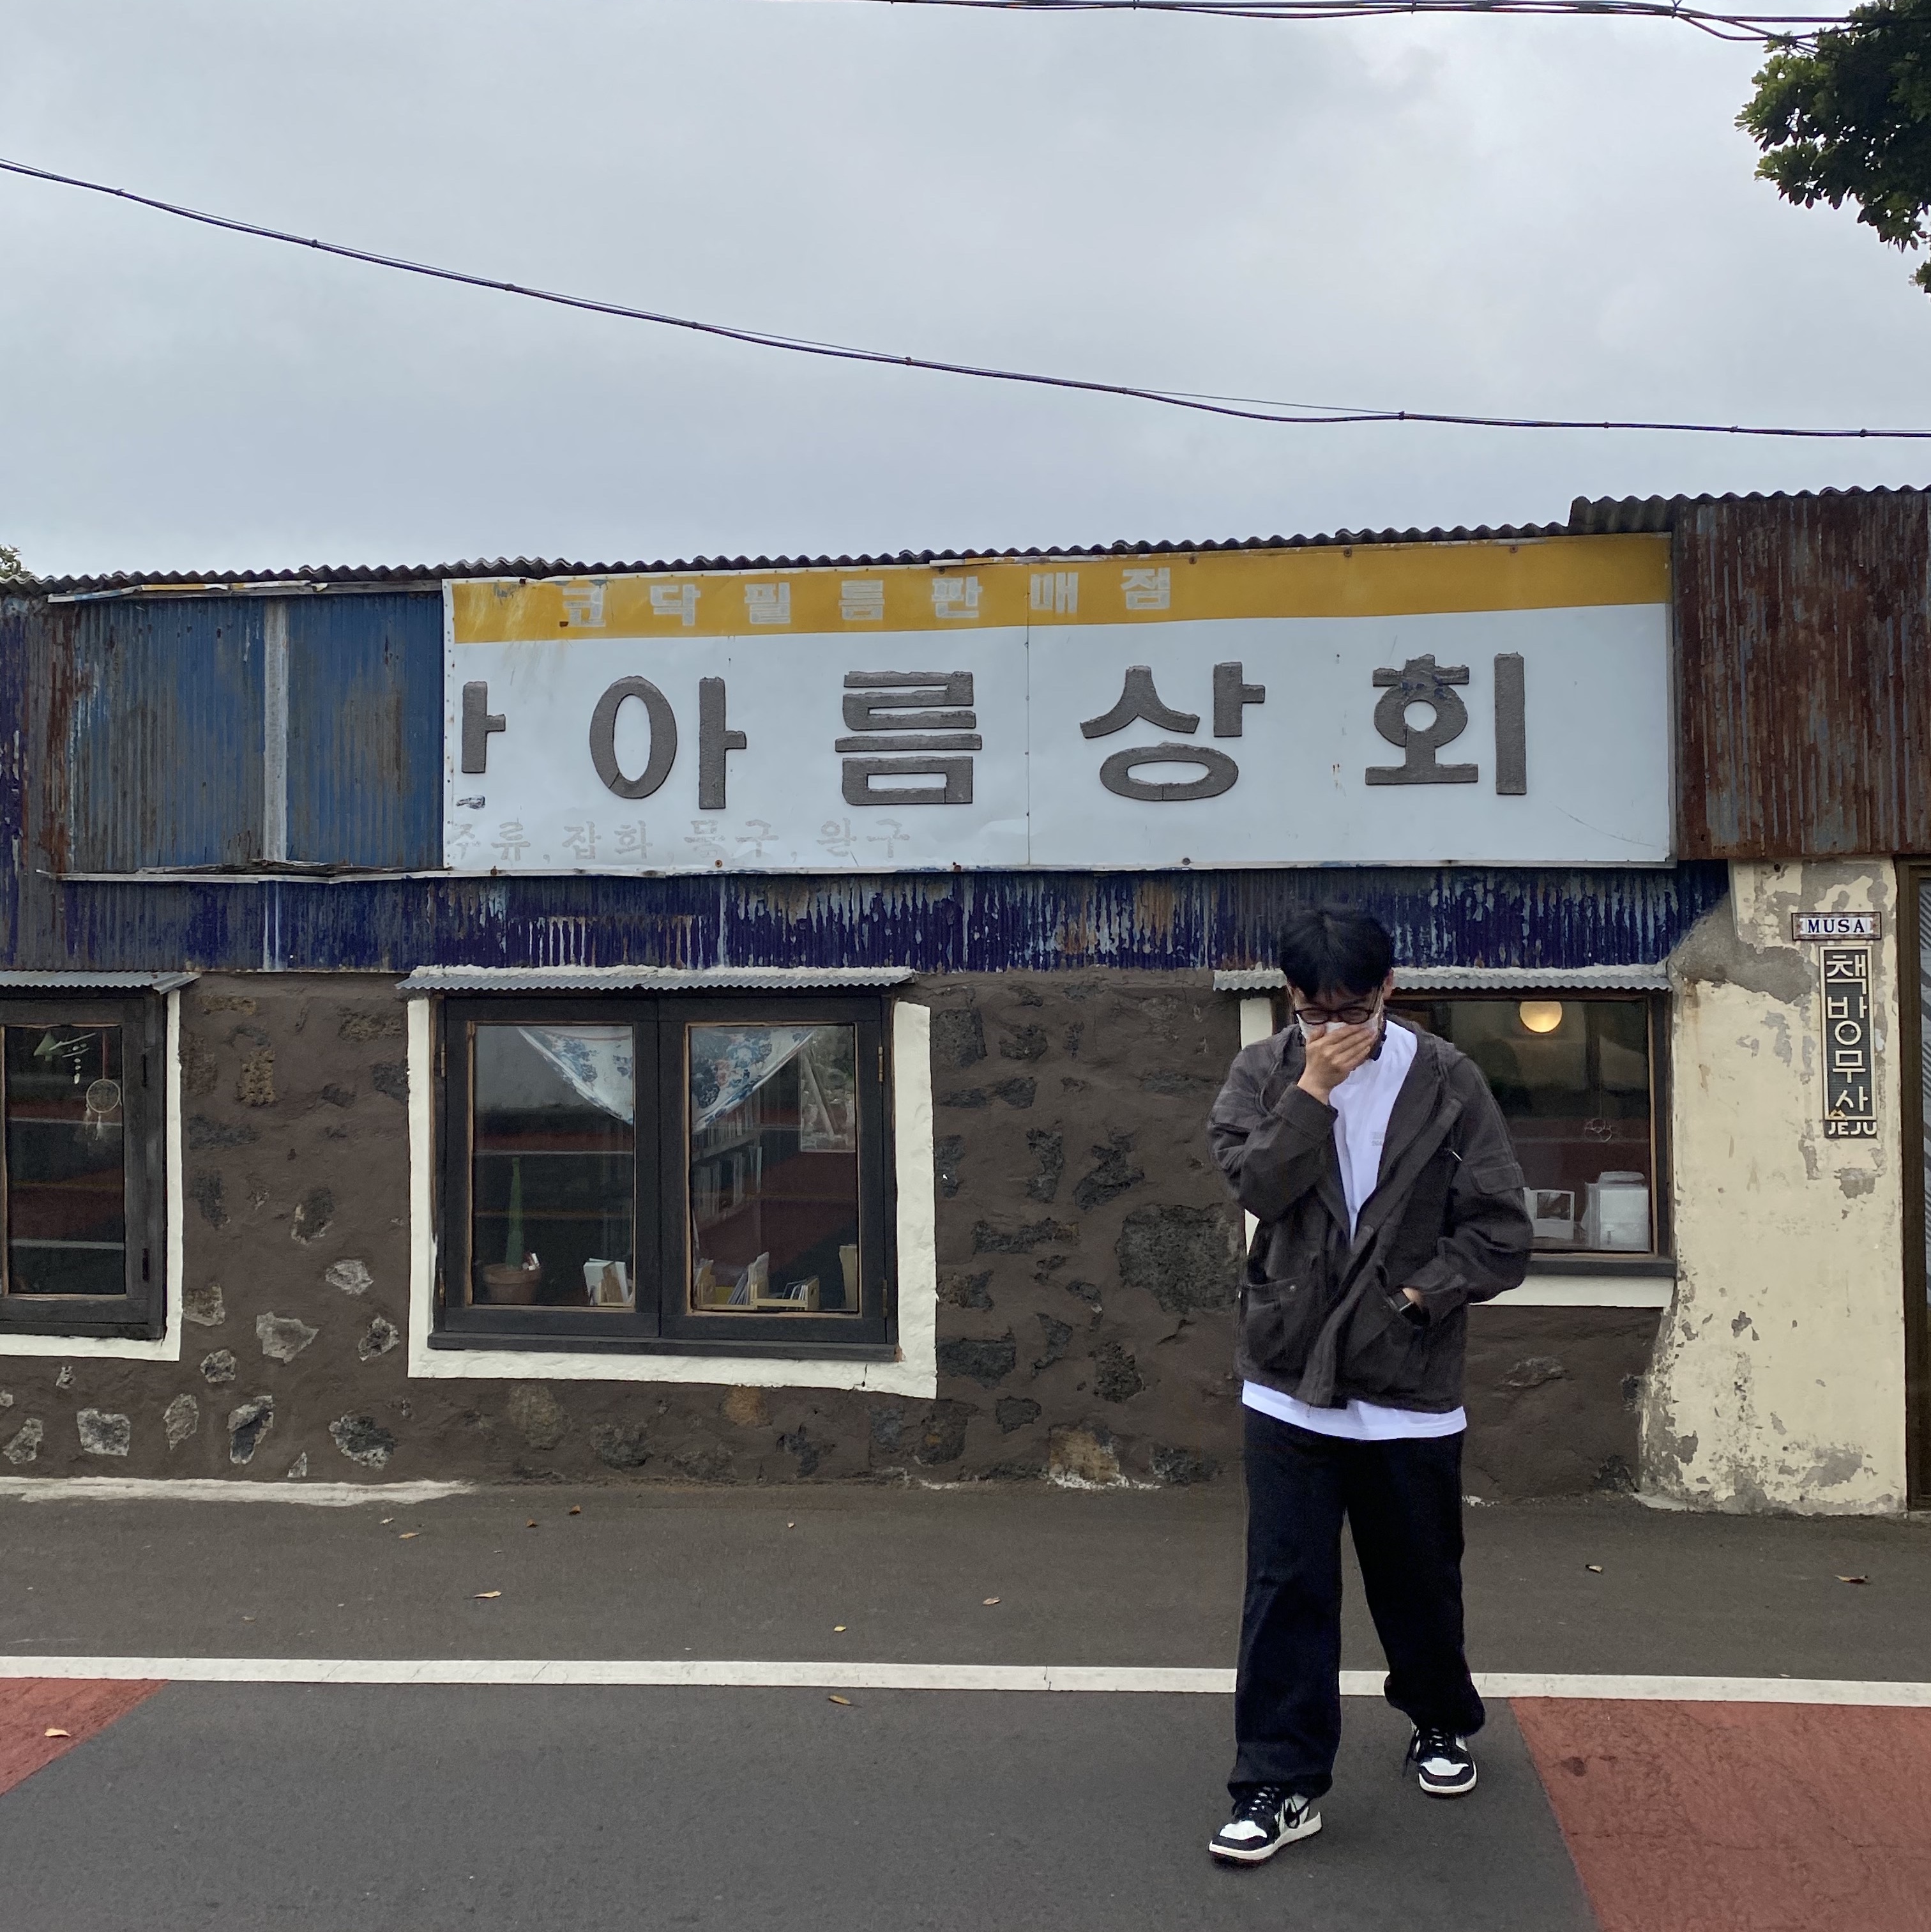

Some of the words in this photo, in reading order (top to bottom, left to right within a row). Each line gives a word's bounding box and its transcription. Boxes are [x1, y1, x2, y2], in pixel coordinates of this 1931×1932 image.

[1808, 918, 1865, 933] MUSA
[1826, 954, 1868, 1112] 책방무사
[1828, 1122, 1877, 1135] JEJU
